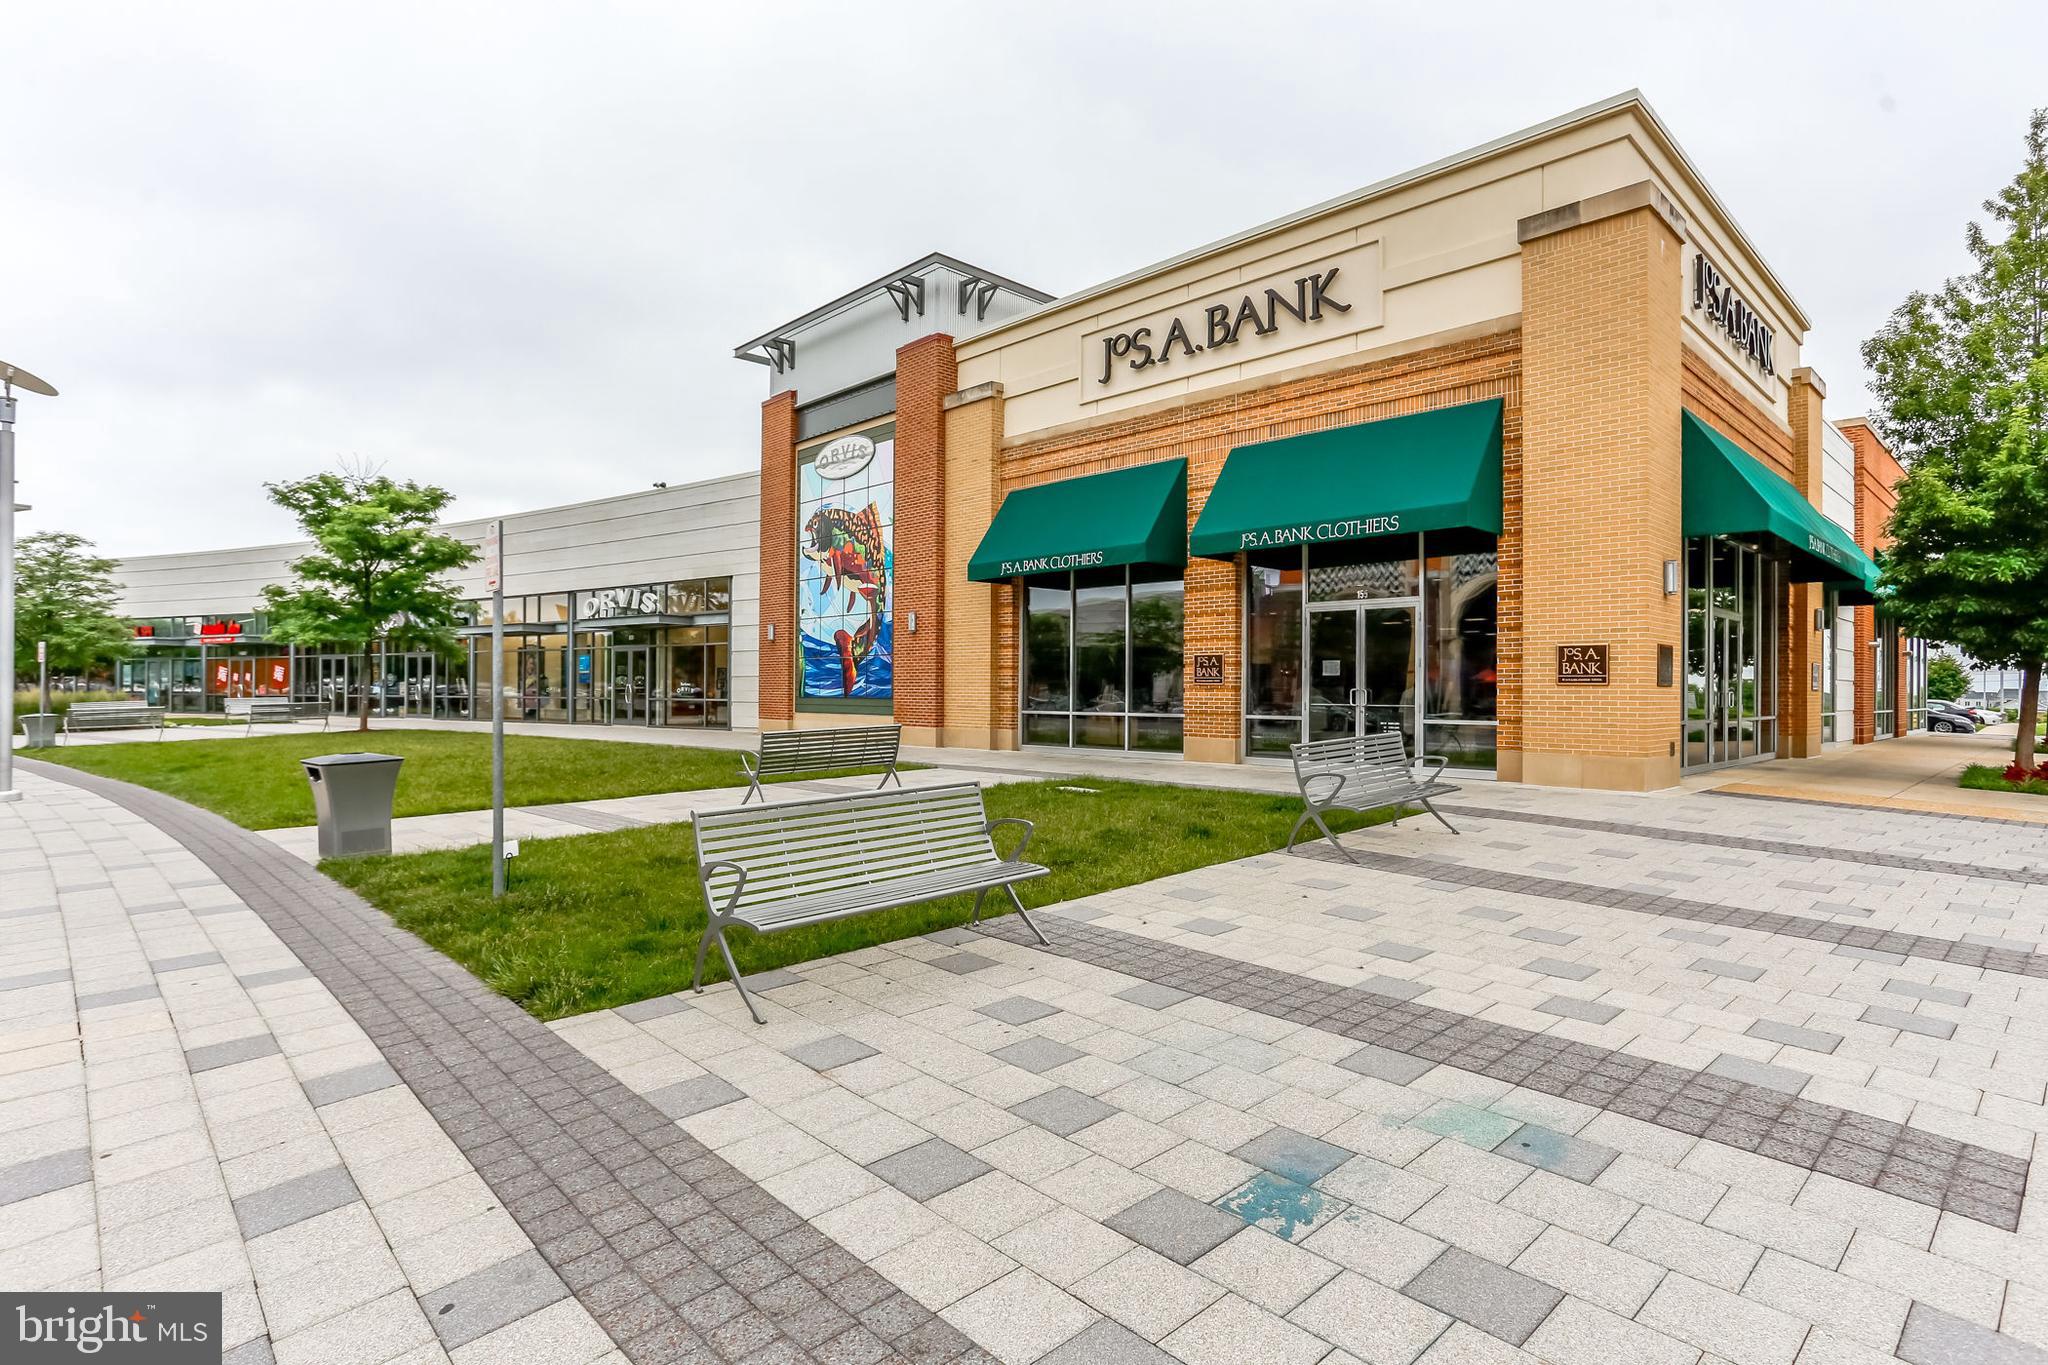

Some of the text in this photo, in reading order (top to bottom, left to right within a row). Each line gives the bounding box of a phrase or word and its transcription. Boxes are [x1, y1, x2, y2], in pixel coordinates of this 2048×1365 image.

[819, 442, 870, 469] ORVIS
[1274, 525, 1315, 544] BANK
[1316, 515, 1400, 540] CLOTHIERS
[1023, 557, 1049, 571] BANK
[1050, 551, 1103, 569] CLOTHIERS
[583, 587, 659, 617] ORVIS
[1196, 667, 1220, 677] BANK
[1562, 662, 1603, 674] BANK
